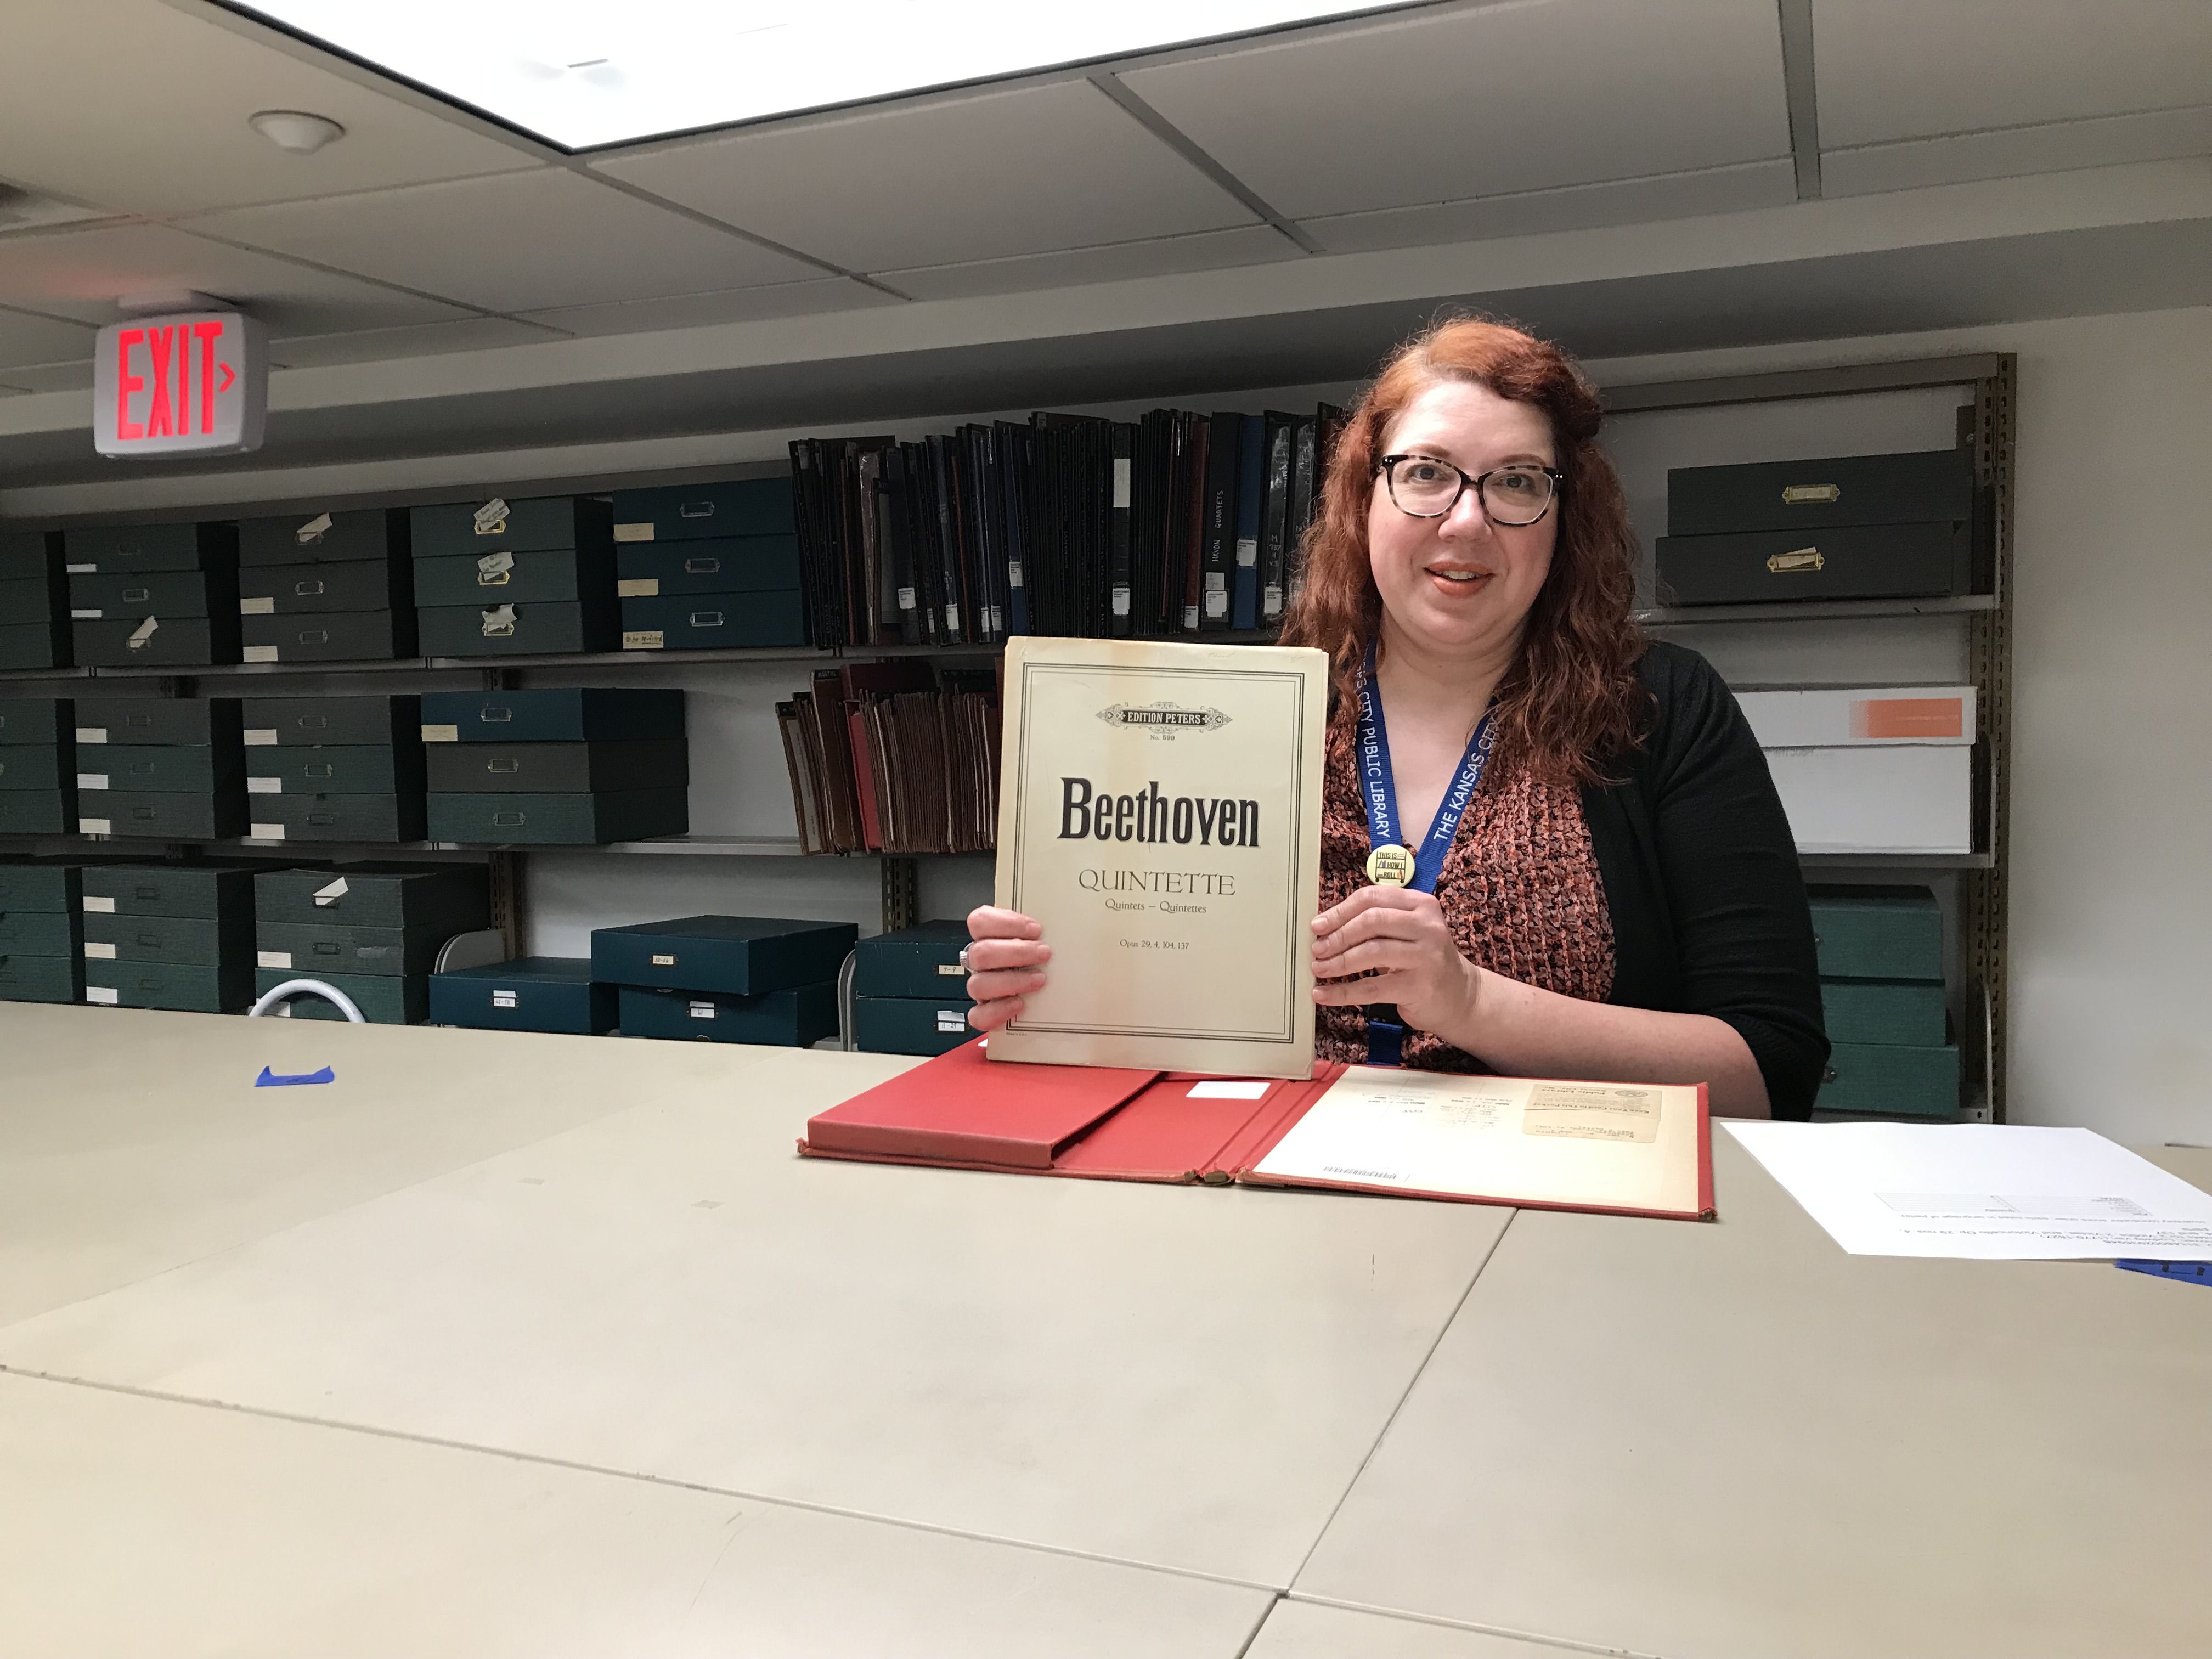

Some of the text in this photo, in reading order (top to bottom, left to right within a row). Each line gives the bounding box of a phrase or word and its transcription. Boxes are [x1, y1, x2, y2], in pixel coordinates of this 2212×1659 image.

[117, 321, 223, 440] EXIT
[1212, 490, 1224, 562] HAYDN QUARTETS
[1127, 712, 1201, 724] EDITION PETERS
[1362, 727, 1381, 777] PUBLIC
[1433, 712, 1498, 840] THE KANSAS CITY
[1057, 777, 1261, 848] Beethoven
[1369, 781, 1391, 838] LIBRARY
[1079, 868, 1236, 895] QUINTETTE
[1105, 898, 1145, 911] Quintets
[1159, 900, 1207, 914] Quintettes
[1120, 939, 1138, 949] Opus
[1141, 940, 1152, 949] 29,
[1178, 941, 1190, 950] 137
